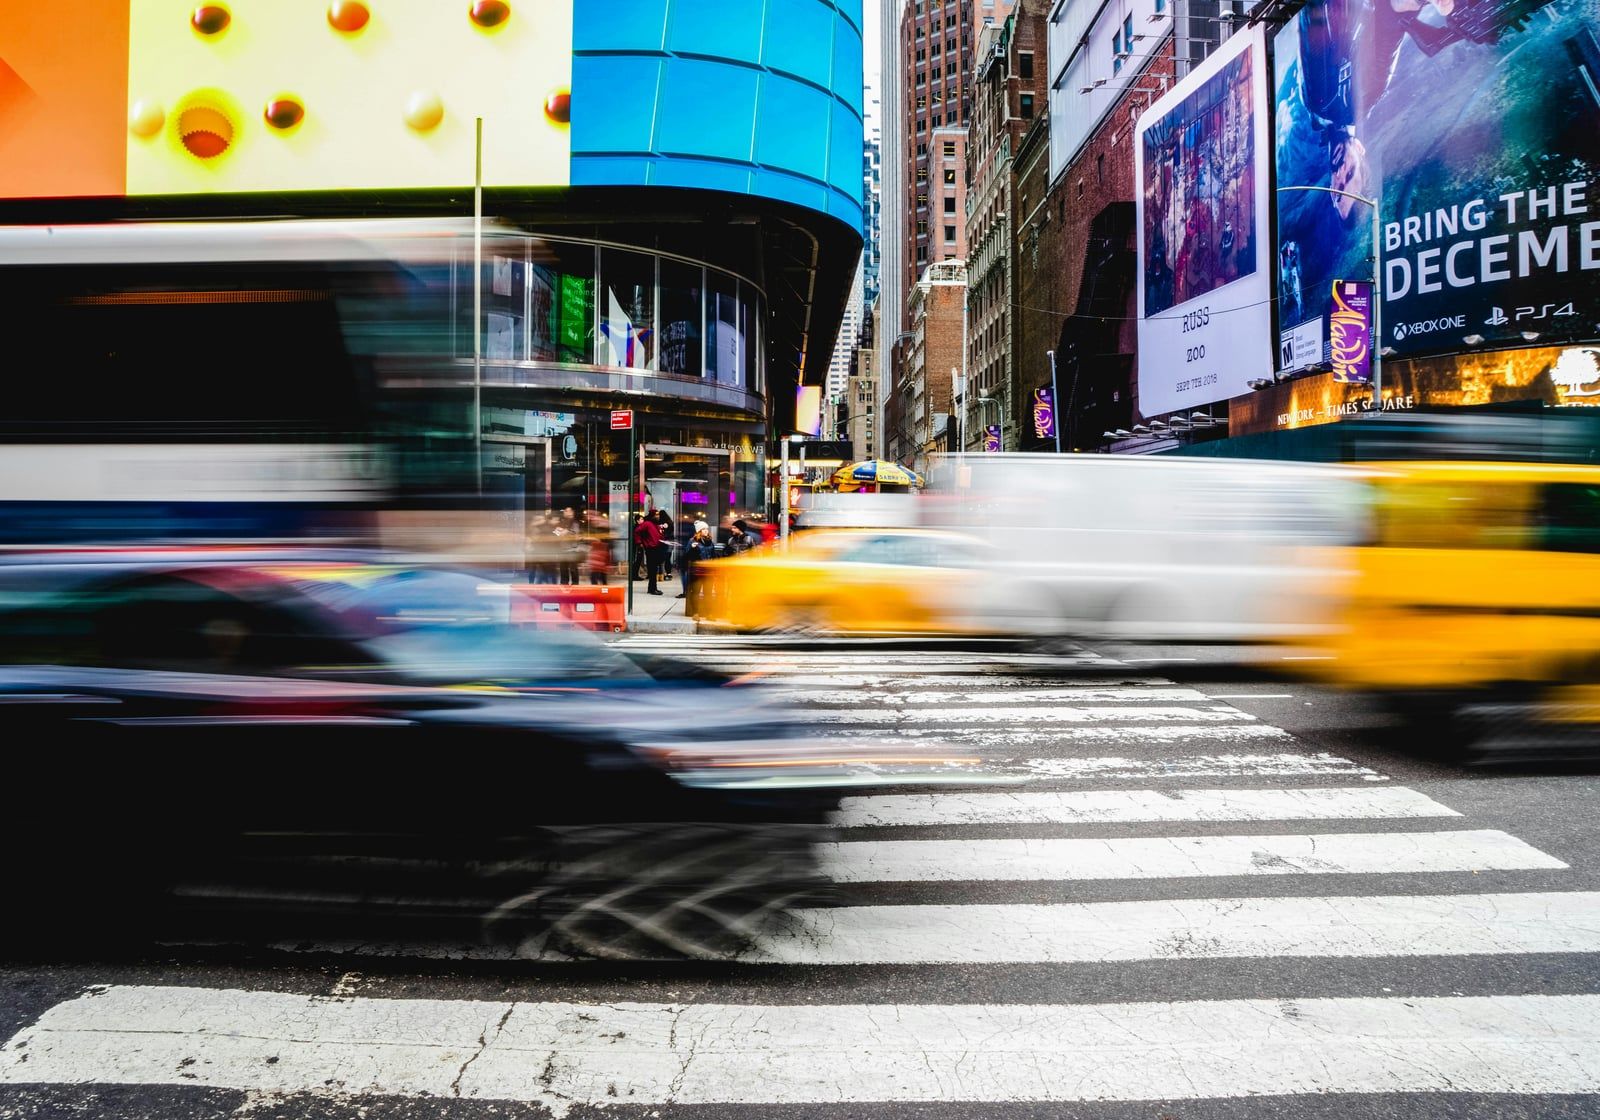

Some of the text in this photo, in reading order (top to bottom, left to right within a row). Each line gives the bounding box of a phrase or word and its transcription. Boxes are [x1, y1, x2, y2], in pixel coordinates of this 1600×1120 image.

[1385, 181, 1588, 252] BRING THE
[1182, 306, 1210, 333] RUSS
[1515, 302, 1576, 321] PS4
[1408, 314, 1466, 335] XBOX ONE
[1186, 344, 1206, 363] ZOO
[1282, 341, 1293, 367] M
[1176, 373, 1218, 392] SEPT 7TH 2018
[1326, 402, 1358, 418] TIMES
